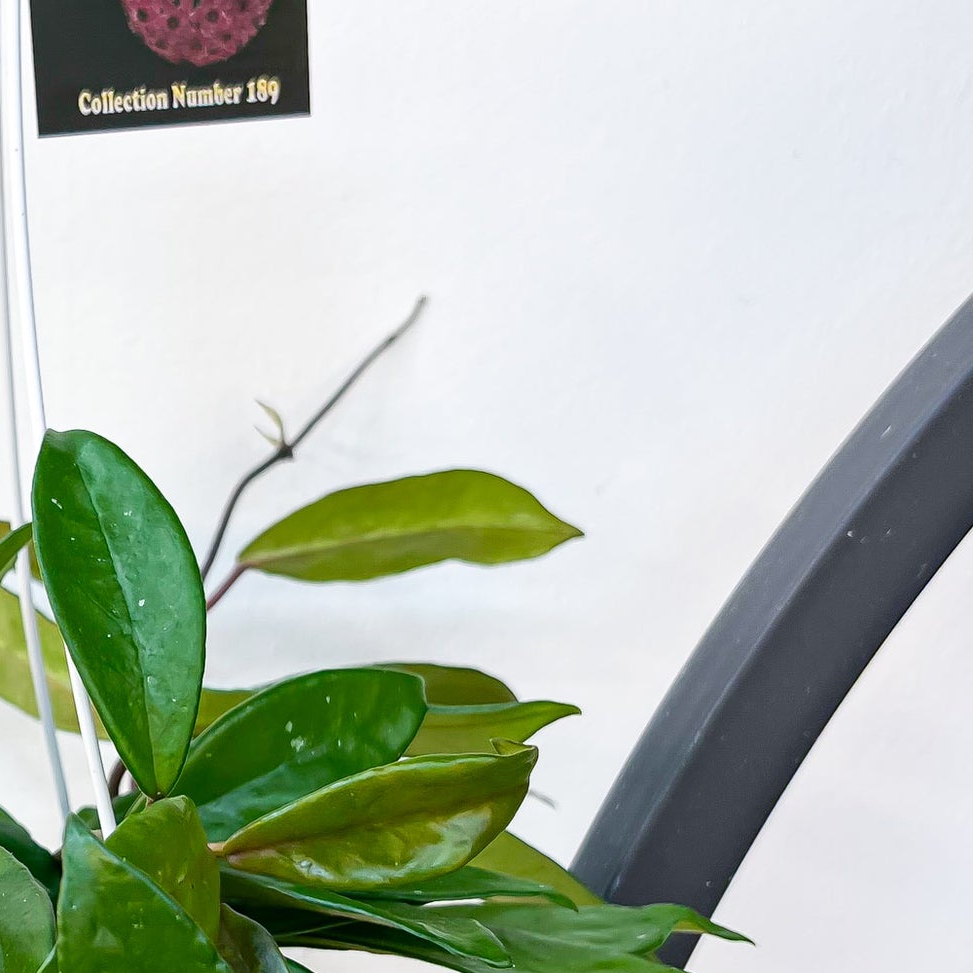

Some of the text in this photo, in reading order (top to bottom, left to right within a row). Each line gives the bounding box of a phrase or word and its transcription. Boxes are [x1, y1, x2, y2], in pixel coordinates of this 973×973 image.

[78, 76, 281, 116] Collection Number 189
